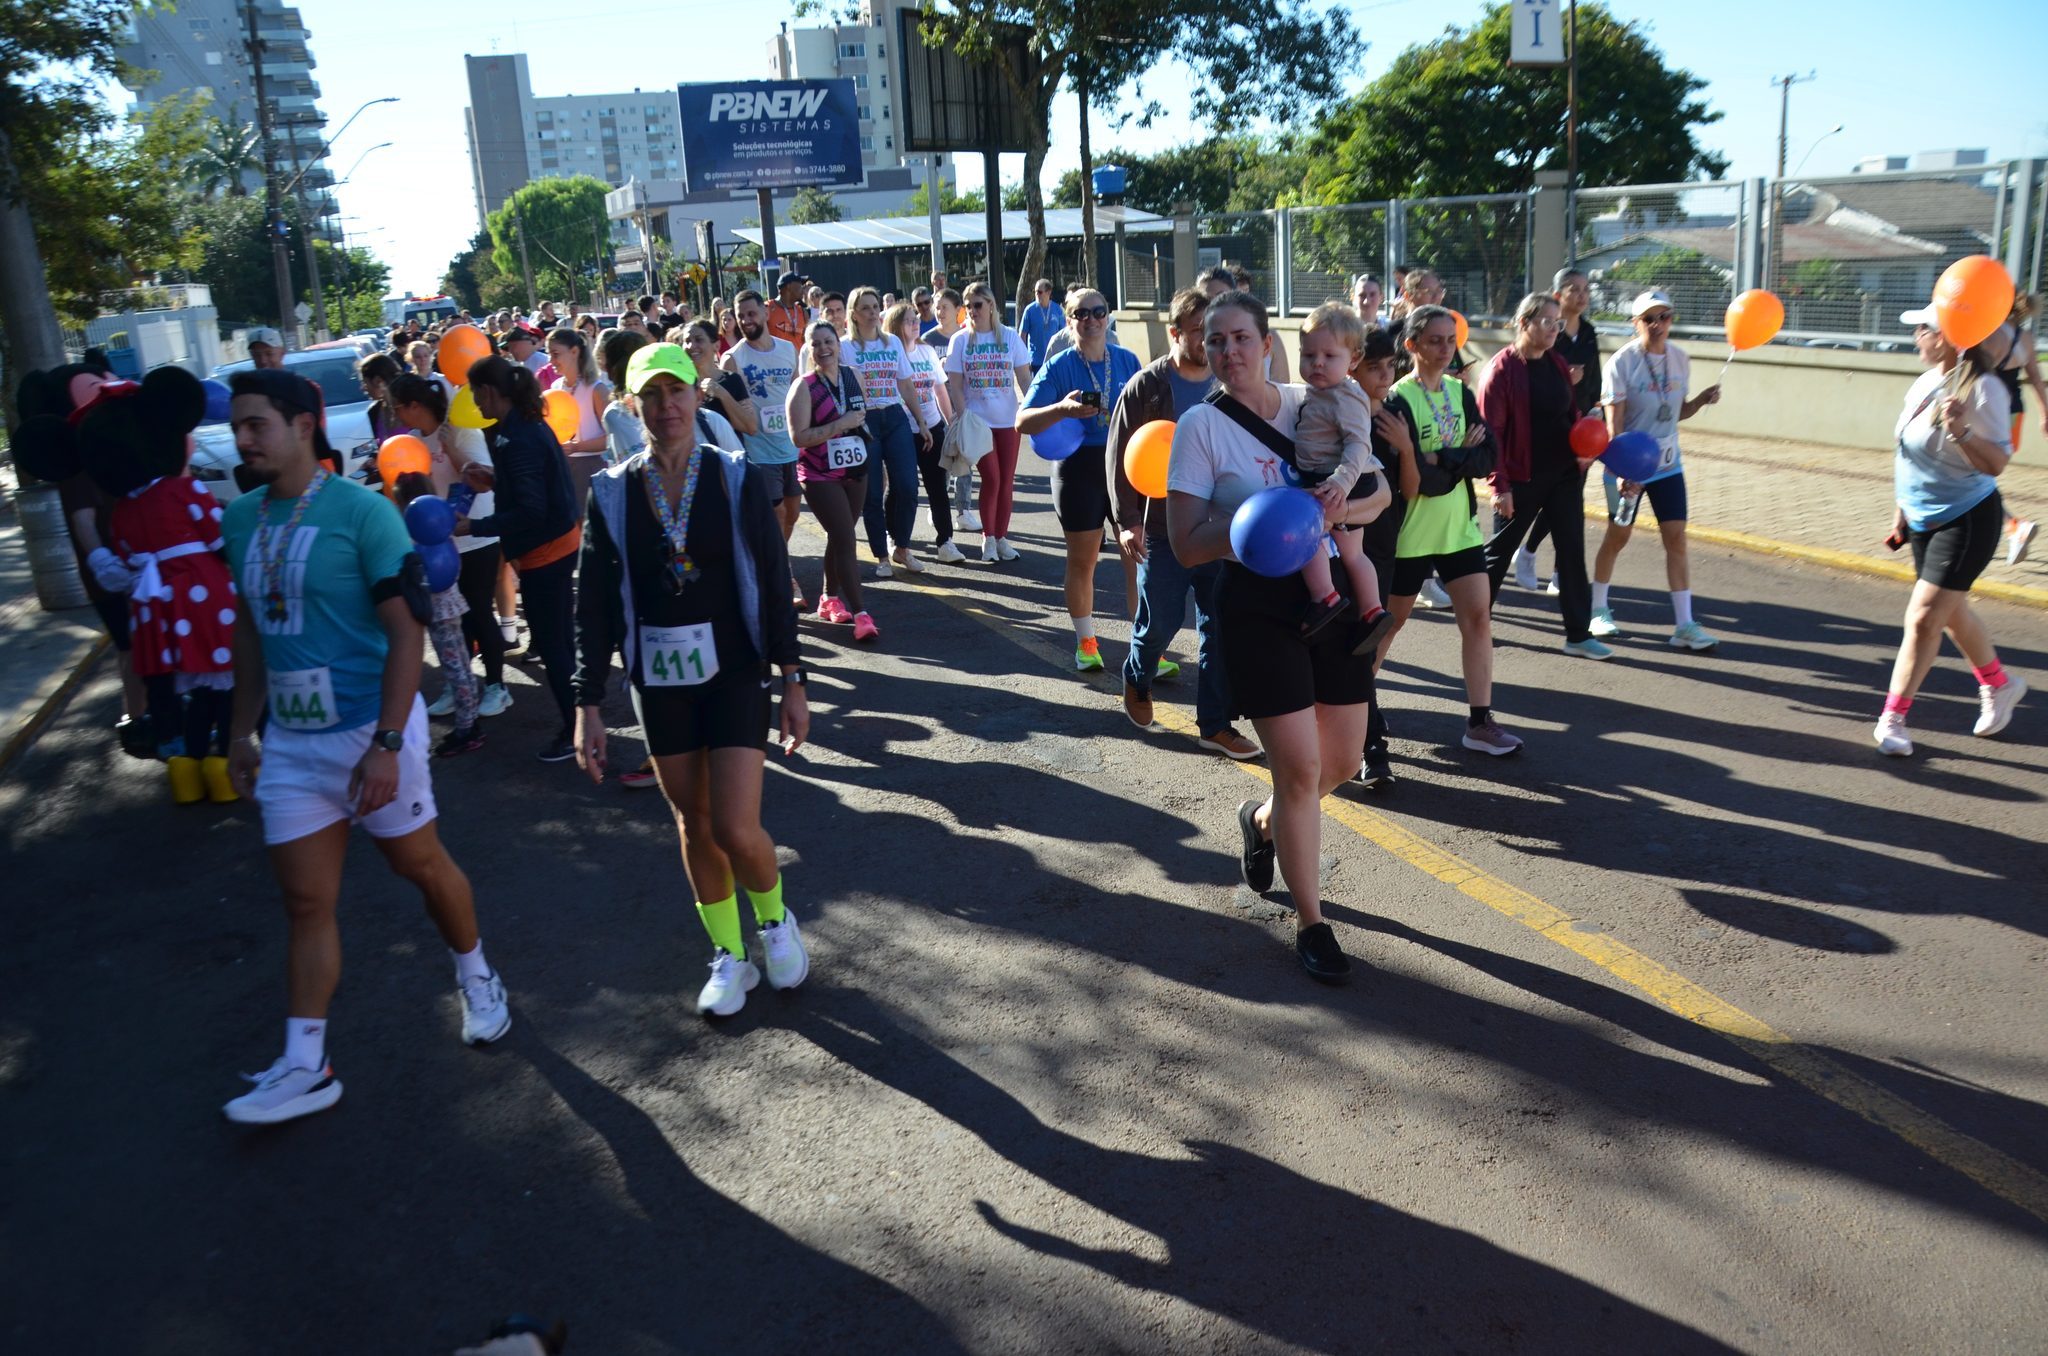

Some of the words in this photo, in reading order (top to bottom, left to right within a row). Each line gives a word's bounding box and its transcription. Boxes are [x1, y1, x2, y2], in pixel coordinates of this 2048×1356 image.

[709, 89, 828, 122] PBNEW
[739, 119, 831, 134] SISTEMAS
[733, 142, 765, 152] Soluções
[767, 140, 813, 150] tecnológicas
[746, 150, 777, 159] produtos
[785, 148, 813, 157] serviços.
[712, 170, 753, 179] pbnew.com.br
[772, 168, 791, 176] pbnew
[965, 342, 1009, 355] JUNTOS
[865, 362, 880, 370] POR
[768, 415, 787, 430] 48
[834, 447, 863, 466] 636
[652, 647, 705, 680] 411
[276, 692, 327, 723] 444
